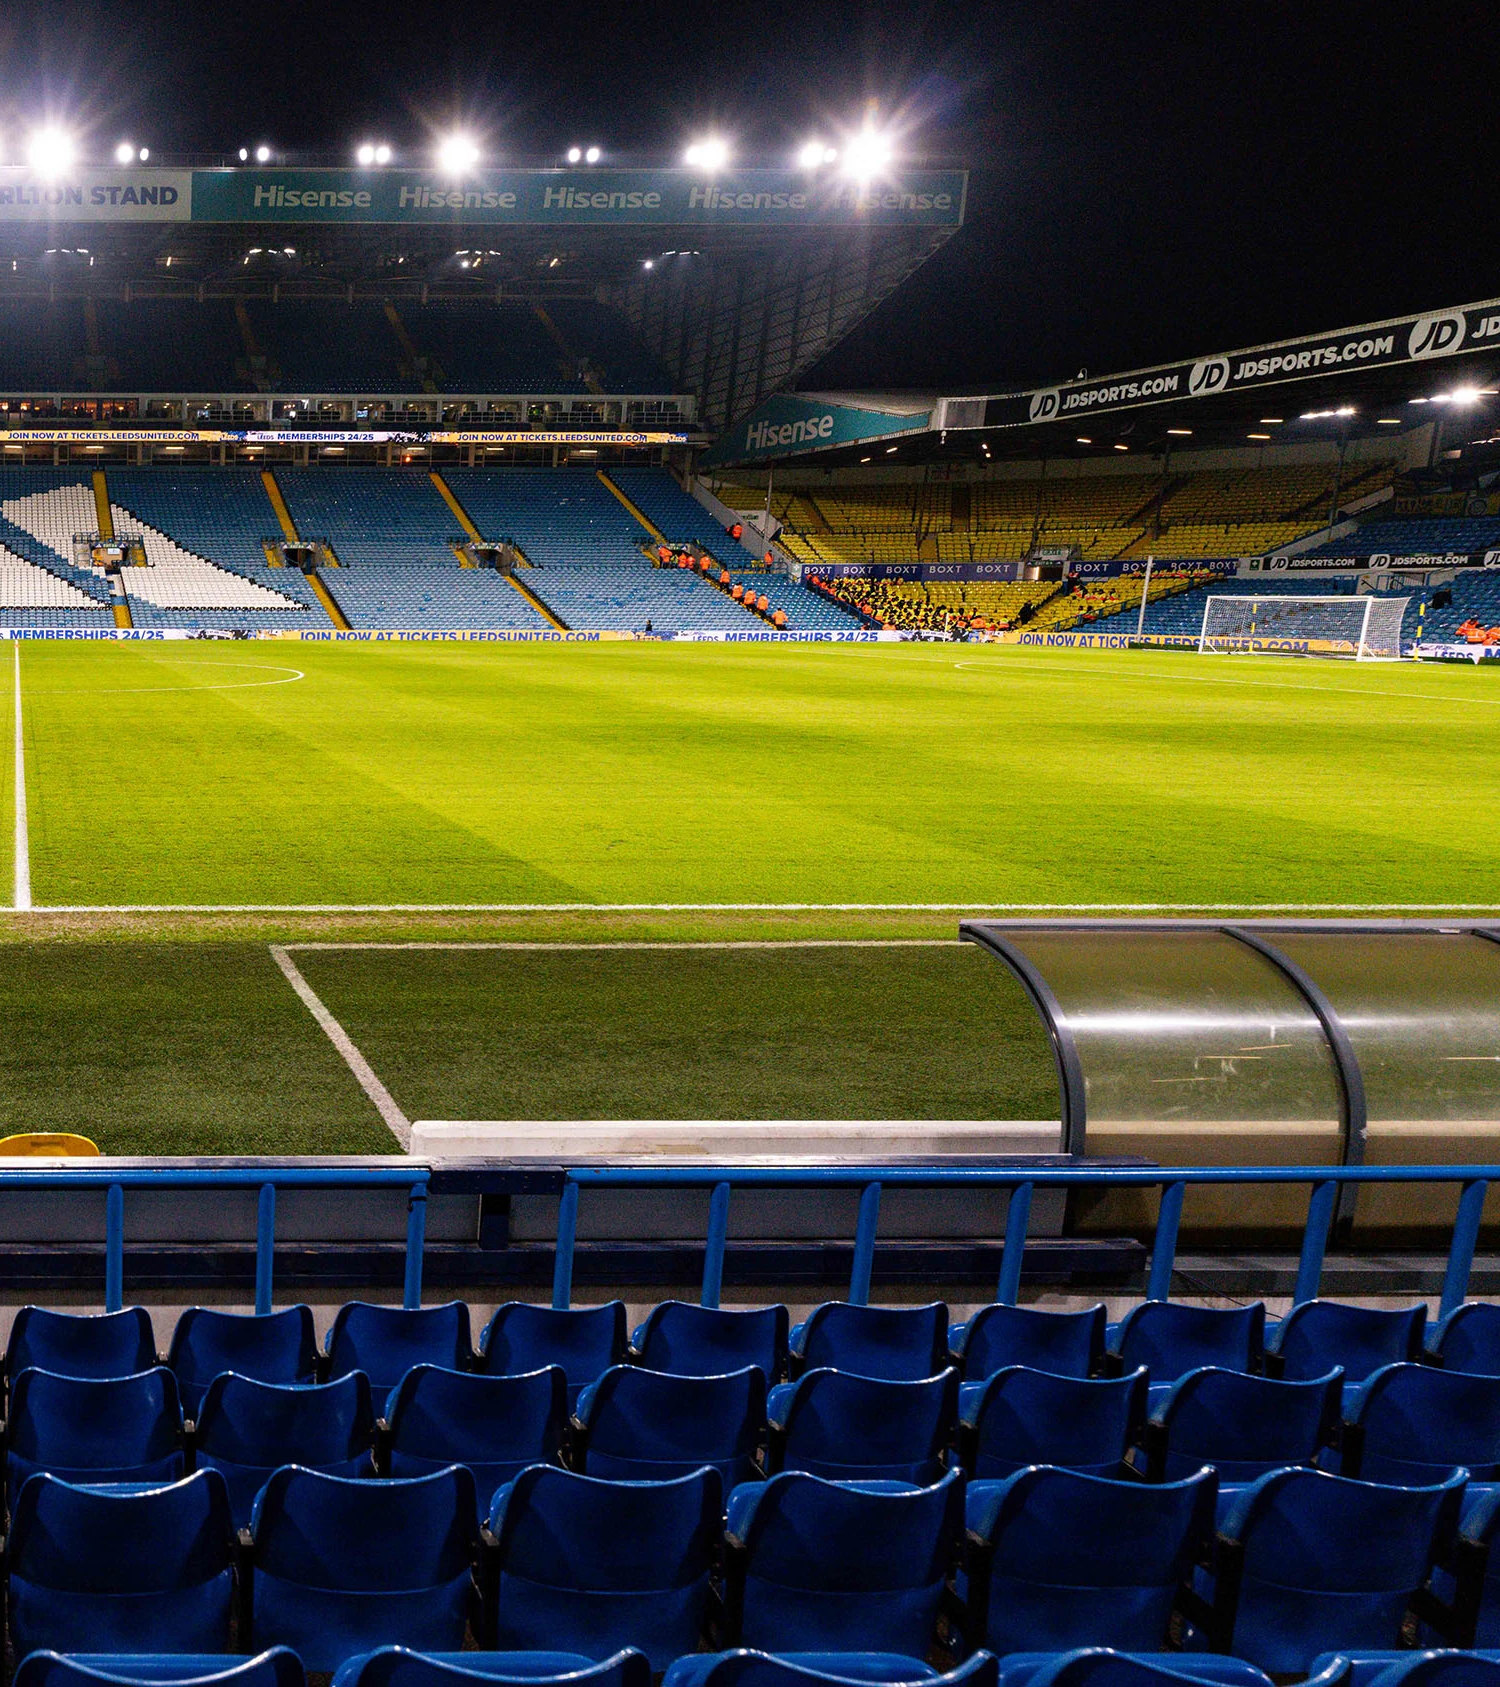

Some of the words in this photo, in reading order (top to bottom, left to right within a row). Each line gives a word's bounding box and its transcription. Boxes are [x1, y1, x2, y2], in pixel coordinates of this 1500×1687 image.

[90, 186, 179, 206] STAND
[253, 185, 372, 208] Hisense
[400, 186, 517, 209] Hisense
[543, 186, 661, 209] Hisense
[688, 186, 807, 209] Hisense
[1233, 335, 1394, 380] JDSPORTS.COM
[1062, 375, 1179, 410] JDSPORTS.COM
[277, 432, 345, 440] MEMBERSHIPS
[347, 432, 374, 441] 24/25
[746, 414, 834, 450] Hisense
[1290, 558, 1355, 567] JDSPORTS.COM
[1392, 555, 1468, 566] JDSPORTS.COM
[804, 566, 832, 574] BOXT
[843, 566, 873, 574] BOXT
[886, 565, 917, 574] BOXT
[929, 565, 962, 574] BOXT
[976, 565, 1010, 574] BOXT
[1075, 563, 1109, 572] BOXT
[1122, 563, 1156, 571] BOX
[1209, 561, 1237, 570] BOXT
[10, 630, 118, 639] MEMBERSHIPS
[122, 630, 164, 639] 24/25
[301, 632, 331, 640] JOIN
[336, 632, 371, 640] NOW
[376, 632, 395, 640] AT
[725, 632, 832, 641] MEMBERSHIPS
[837, 632, 878, 641] 24/25
[1017, 635, 1043, 645] JOIN
[1046, 635, 1076, 646] NOW
[1079, 636, 1095, 647] AT
